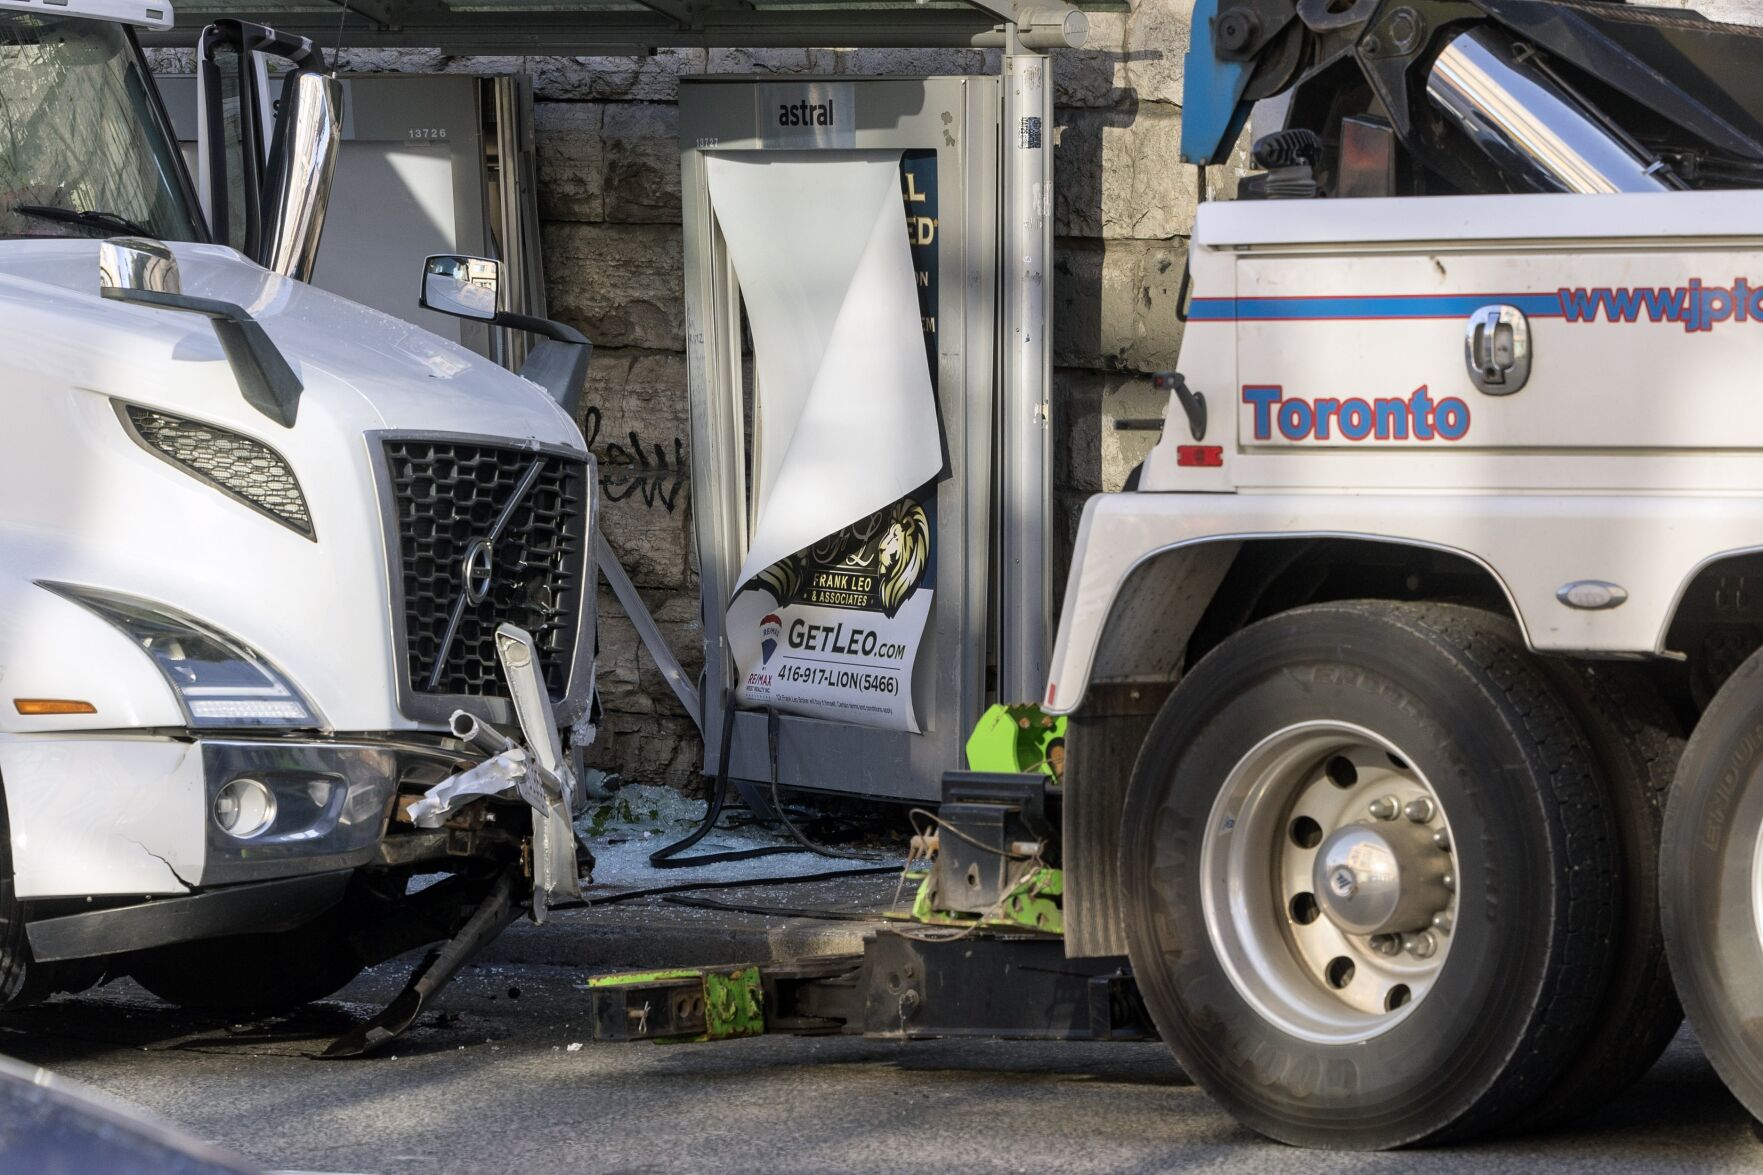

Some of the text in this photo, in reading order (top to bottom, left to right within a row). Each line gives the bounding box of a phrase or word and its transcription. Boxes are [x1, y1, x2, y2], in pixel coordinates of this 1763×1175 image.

[778, 99, 833, 126] astral
[408, 128, 447, 138] 13726
[696, 137, 719, 148] 13727
[1241, 383, 1471, 442] Toronto
[813, 573, 872, 592] FRANK LEO
[811, 590, 868, 607] & ASSOCIATES
[747, 673, 773, 687] RE/MAX
[778, 664, 900, 696] 416-917-LION(5466)
